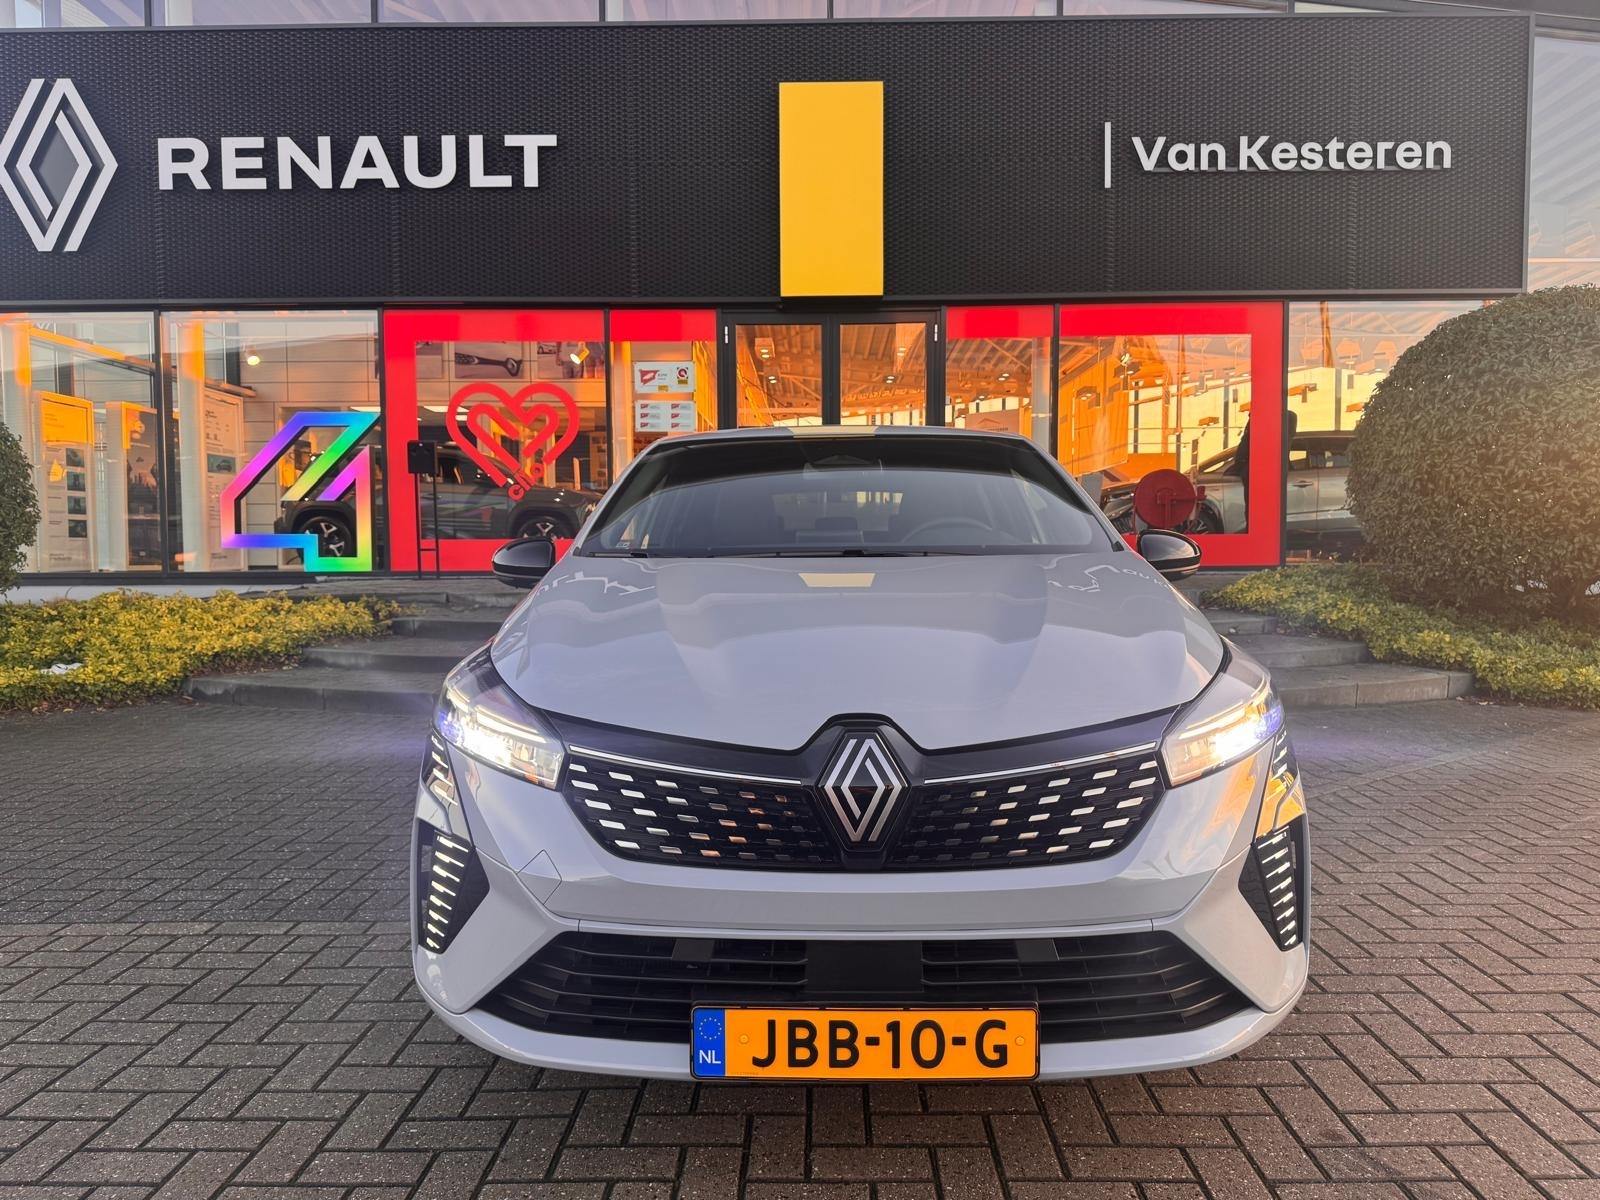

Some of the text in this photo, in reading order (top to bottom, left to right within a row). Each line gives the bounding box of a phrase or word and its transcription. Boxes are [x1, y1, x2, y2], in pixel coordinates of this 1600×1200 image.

[157, 134, 558, 191] RENAULT
[1131, 134, 1453, 172] Van Kesteren
[699, 1049, 722, 1065] NL
[752, 1019, 1009, 1069] JBB-10-G
